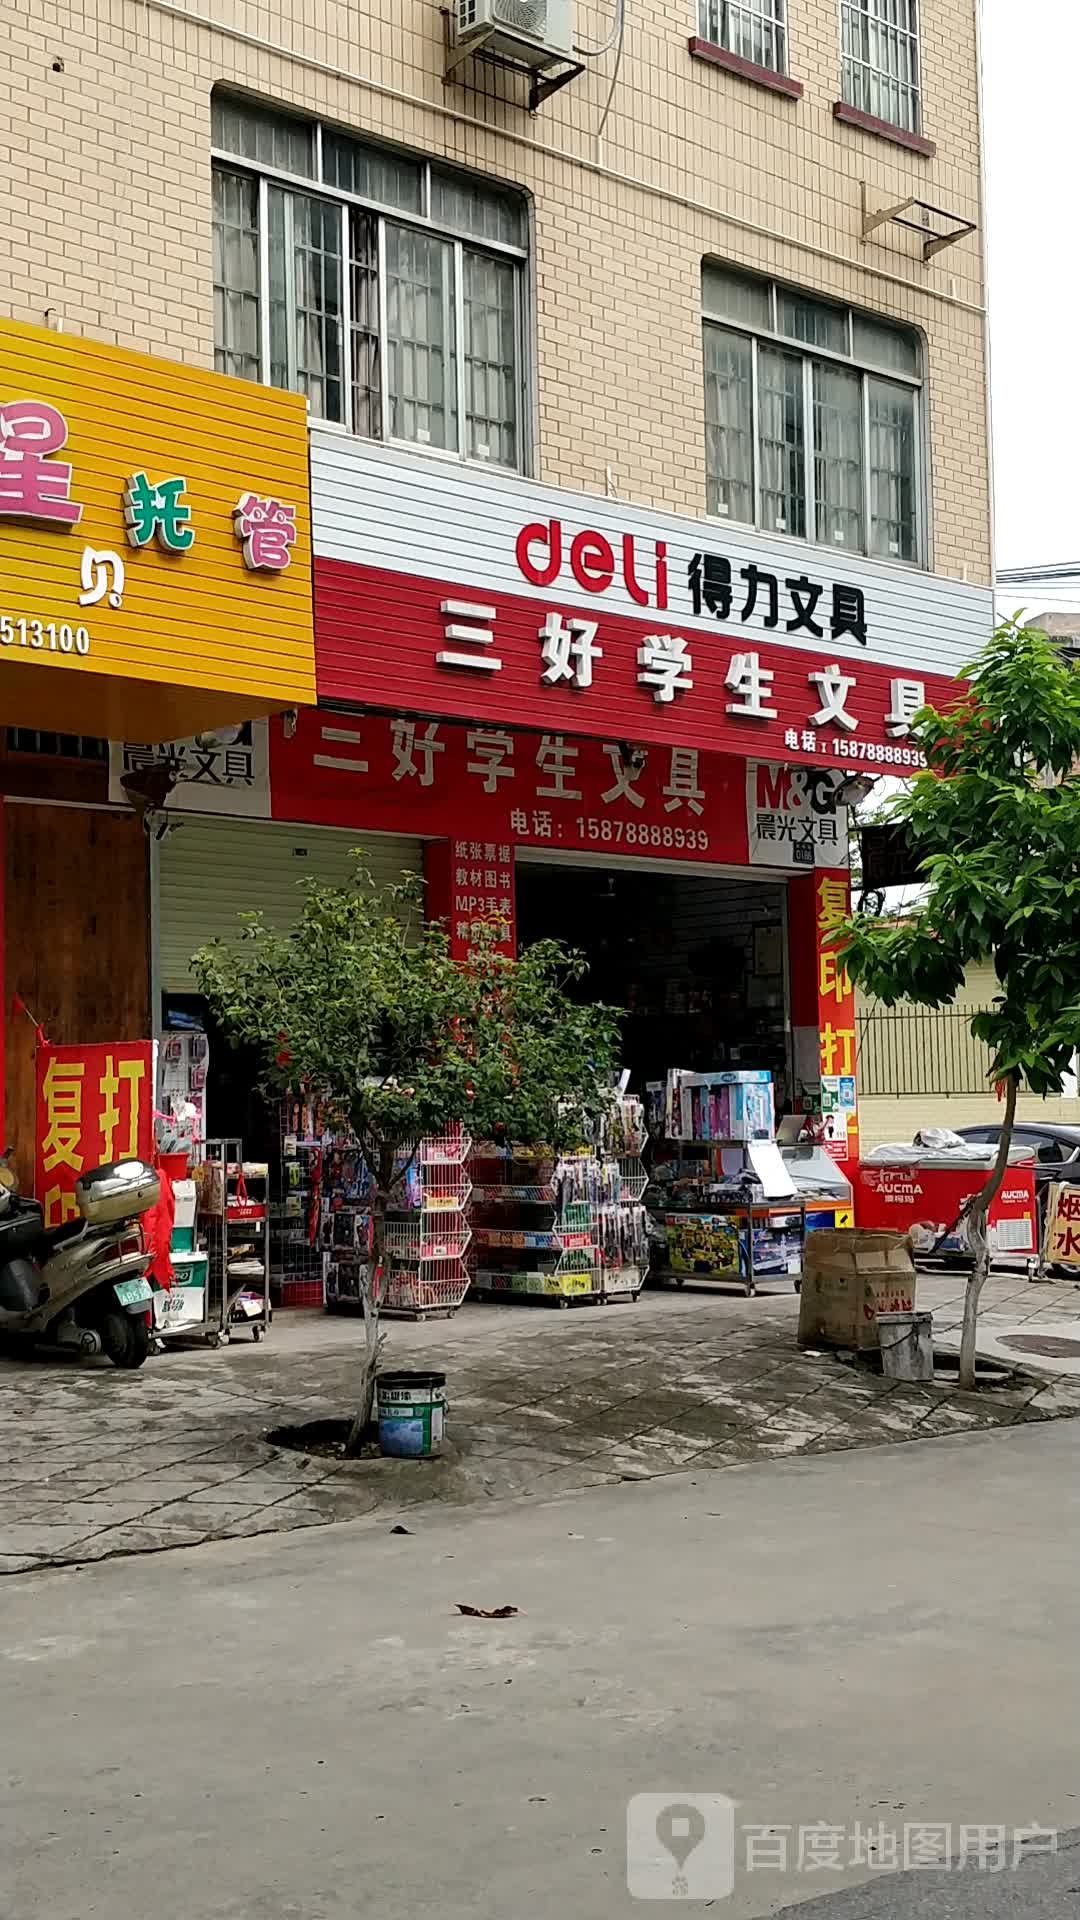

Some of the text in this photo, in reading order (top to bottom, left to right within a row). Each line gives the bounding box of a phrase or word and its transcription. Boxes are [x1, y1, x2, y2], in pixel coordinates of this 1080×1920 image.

[79, 546, 125, 608] 贝
[515, 519, 868, 646] deli 得力文具
[436, 600, 925, 740] 三好学生文具
[313, 708, 706, 816] 三好学生文具
[756, 813, 839, 846] 晨光文具
[455, 841, 511, 863] 纸张票据
[455, 867, 511, 889] 教材图书
[455, 895, 512, 915] MP3手表
[875, 1183, 924, 1194] AUCMA
[1001, 1190, 1030, 1200] AUCMA
